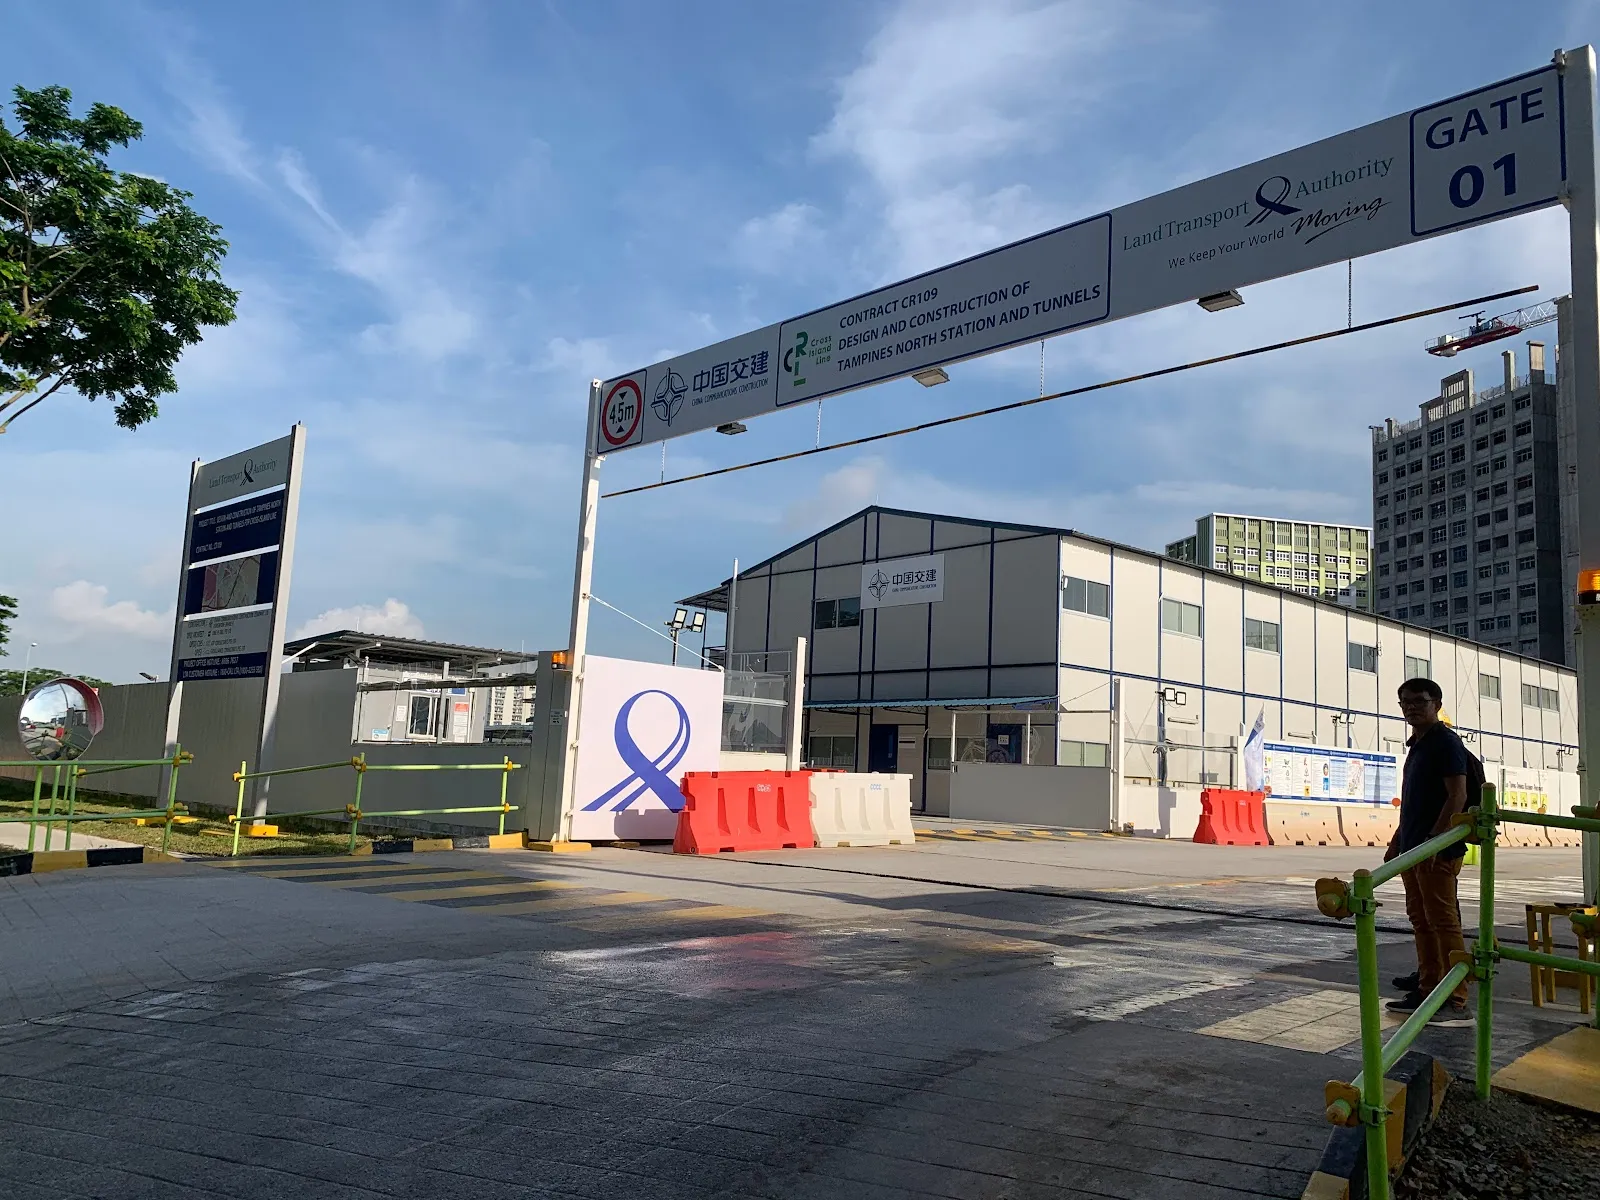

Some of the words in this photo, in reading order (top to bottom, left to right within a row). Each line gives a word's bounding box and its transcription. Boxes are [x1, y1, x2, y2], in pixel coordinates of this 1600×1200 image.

[1425, 87, 1545, 150] GATE
[1447, 152, 1517, 209] 01
[1123, 224, 1163, 251] Land
[1164, 200, 1250, 238] Transport
[1295, 157, 1394, 199] Authority
[1168, 256, 1186, 269] We
[1189, 248, 1216, 264] Keep
[1217, 240, 1246, 255] Your
[1248, 226, 1285, 247] World
[1290, 197, 1392, 235] Moving
[837, 345, 893, 372] TAMPINES
[895, 332, 937, 356] NORTH
[939, 314, 996, 342] STATION
[999, 306, 1030, 326] AND
[1032, 284, 1101, 315] TUNNELS
[838, 327, 879, 351] DESIGN
[881, 320, 907, 338] AND
[909, 287, 1008, 329] CONSTRUCTION
[1011, 280, 1031, 298] OF
[839, 299, 899, 329] CONTRACT
[901, 287, 938, 309] CR109
[808, 343, 832, 358] Island
[811, 335, 832, 347] Cross
[816, 355, 831, 365] Line
[693, 350, 769, 392] 中国交建
[609, 402, 635, 425] 4.5m
[892, 568, 937, 585] 中国交建
